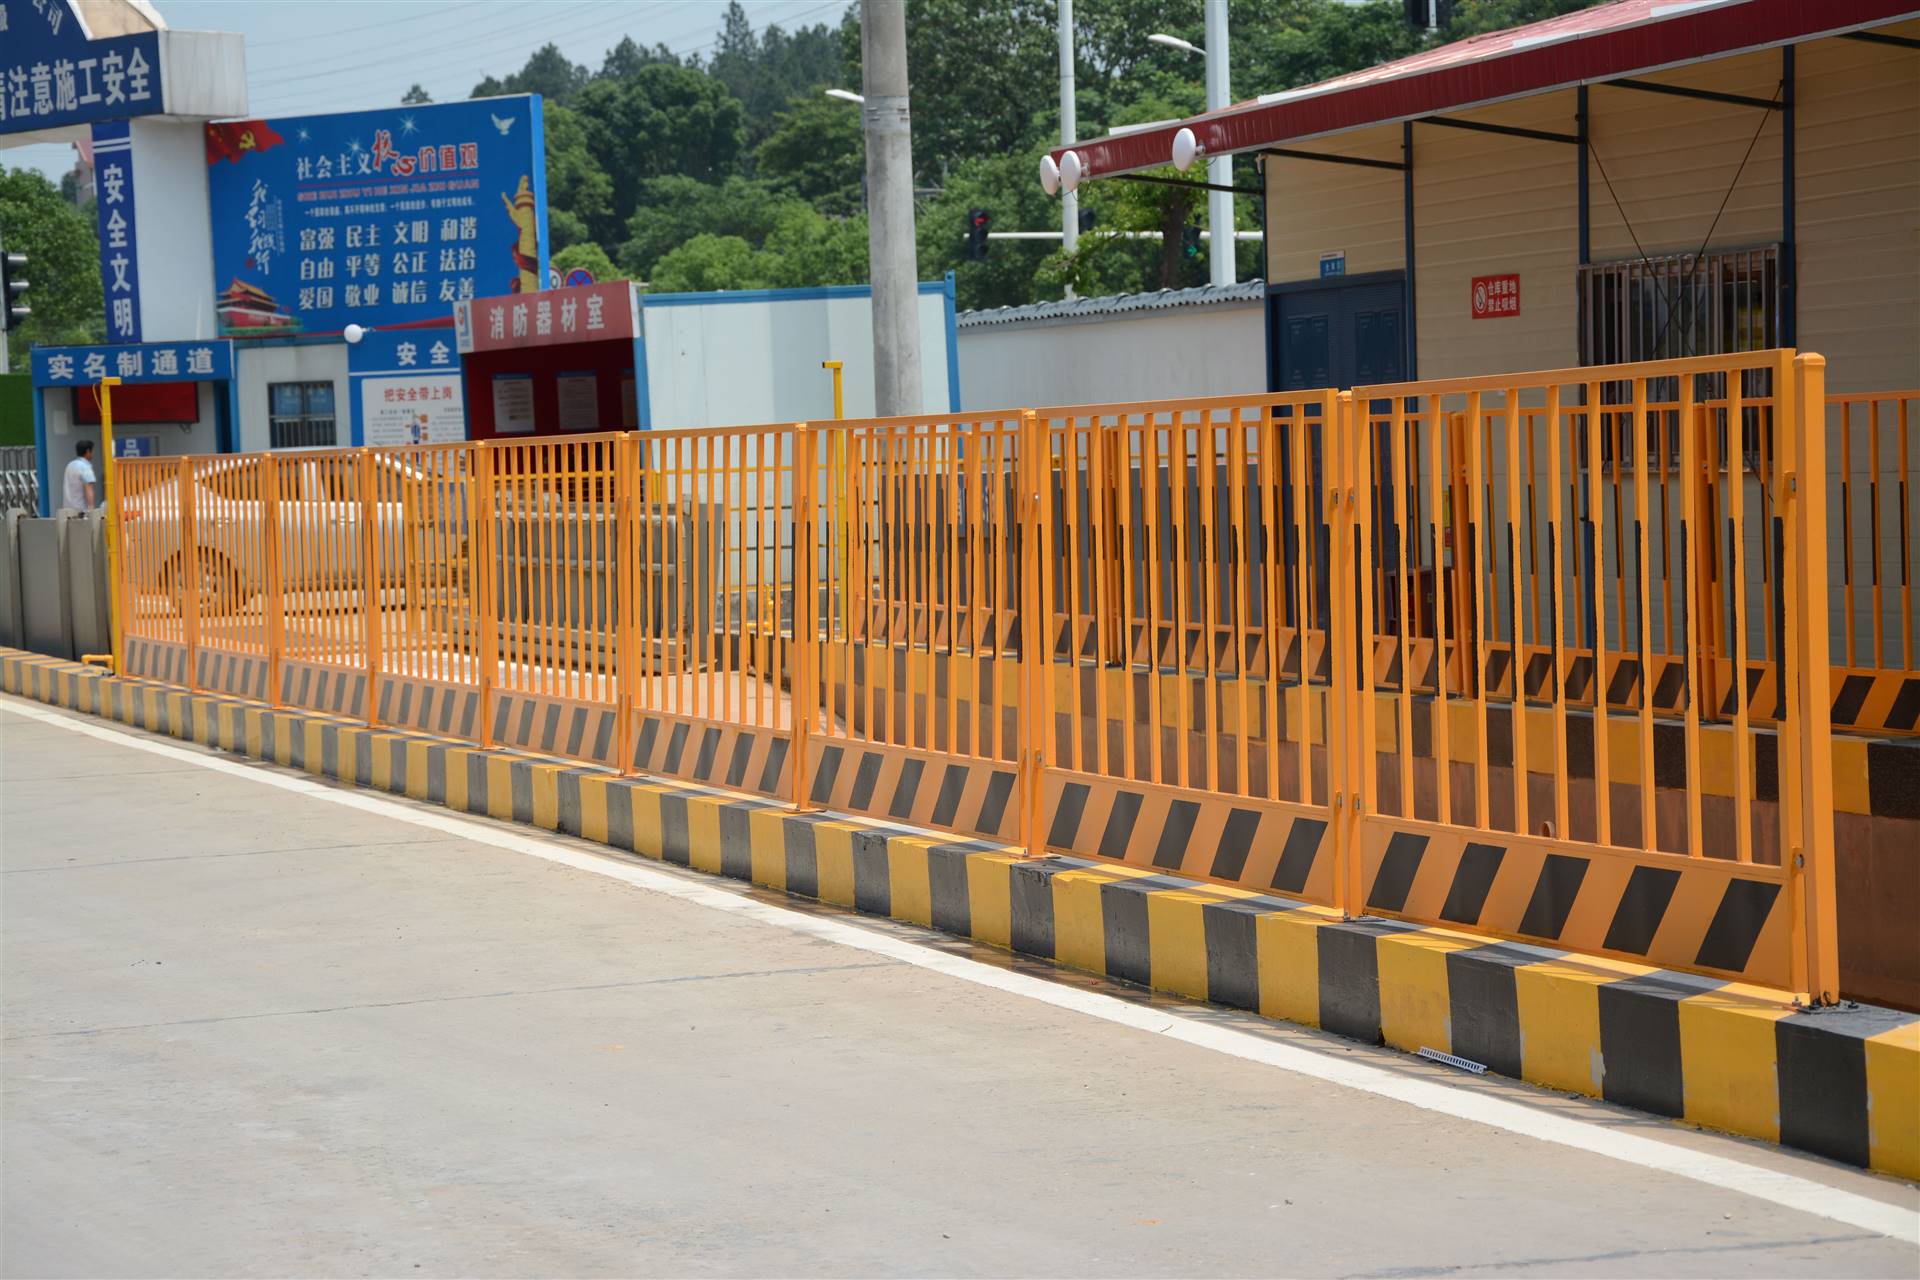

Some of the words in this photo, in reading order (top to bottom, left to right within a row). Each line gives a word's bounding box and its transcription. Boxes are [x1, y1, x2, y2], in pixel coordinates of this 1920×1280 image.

[0, 47, 151, 122] 注意施工安全
[296, 129, 479, 181] 社会主义核心价值观
[103, 163, 133, 338] 安全文明
[299, 227, 335, 251] 富强
[345, 224, 380, 248] 民主
[393, 220, 428, 246] 文明
[440, 216, 477, 242] 和谐
[300, 257, 334, 281] 自由
[345, 253, 380, 278] 平等
[393, 250, 428, 275] 公正
[440, 247, 476, 272] 法治
[298, 286, 333, 310] 爱国
[344, 283, 380, 308] 敬业
[392, 280, 427, 304] 诚信
[439, 277, 475, 302] 友善
[1487, 295, 1517, 313] 禁止吸烟
[490, 295, 605, 340] 消防器材室
[47, 346, 215, 380] 实名制通道
[396, 340, 451, 366] 安全
[384, 386, 453, 402] 把安全带上岗
